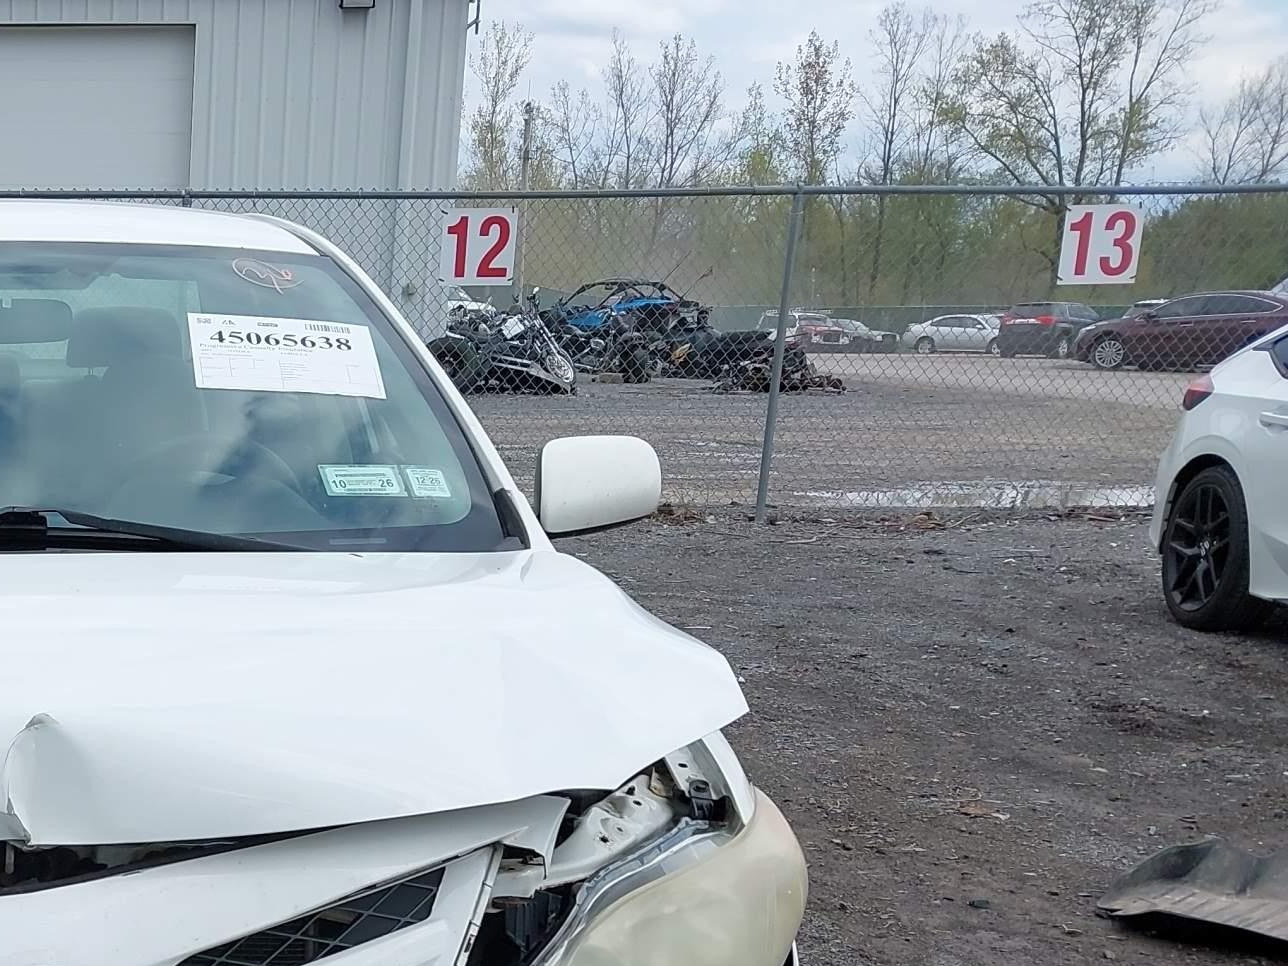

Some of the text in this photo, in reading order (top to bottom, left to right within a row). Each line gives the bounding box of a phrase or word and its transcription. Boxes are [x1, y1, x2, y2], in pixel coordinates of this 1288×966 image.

[447, 215, 511, 279] 12
[1071, 210, 1136, 278] 13
[210, 330, 353, 352] 45065638
[331, 478, 394, 489] 10 26
